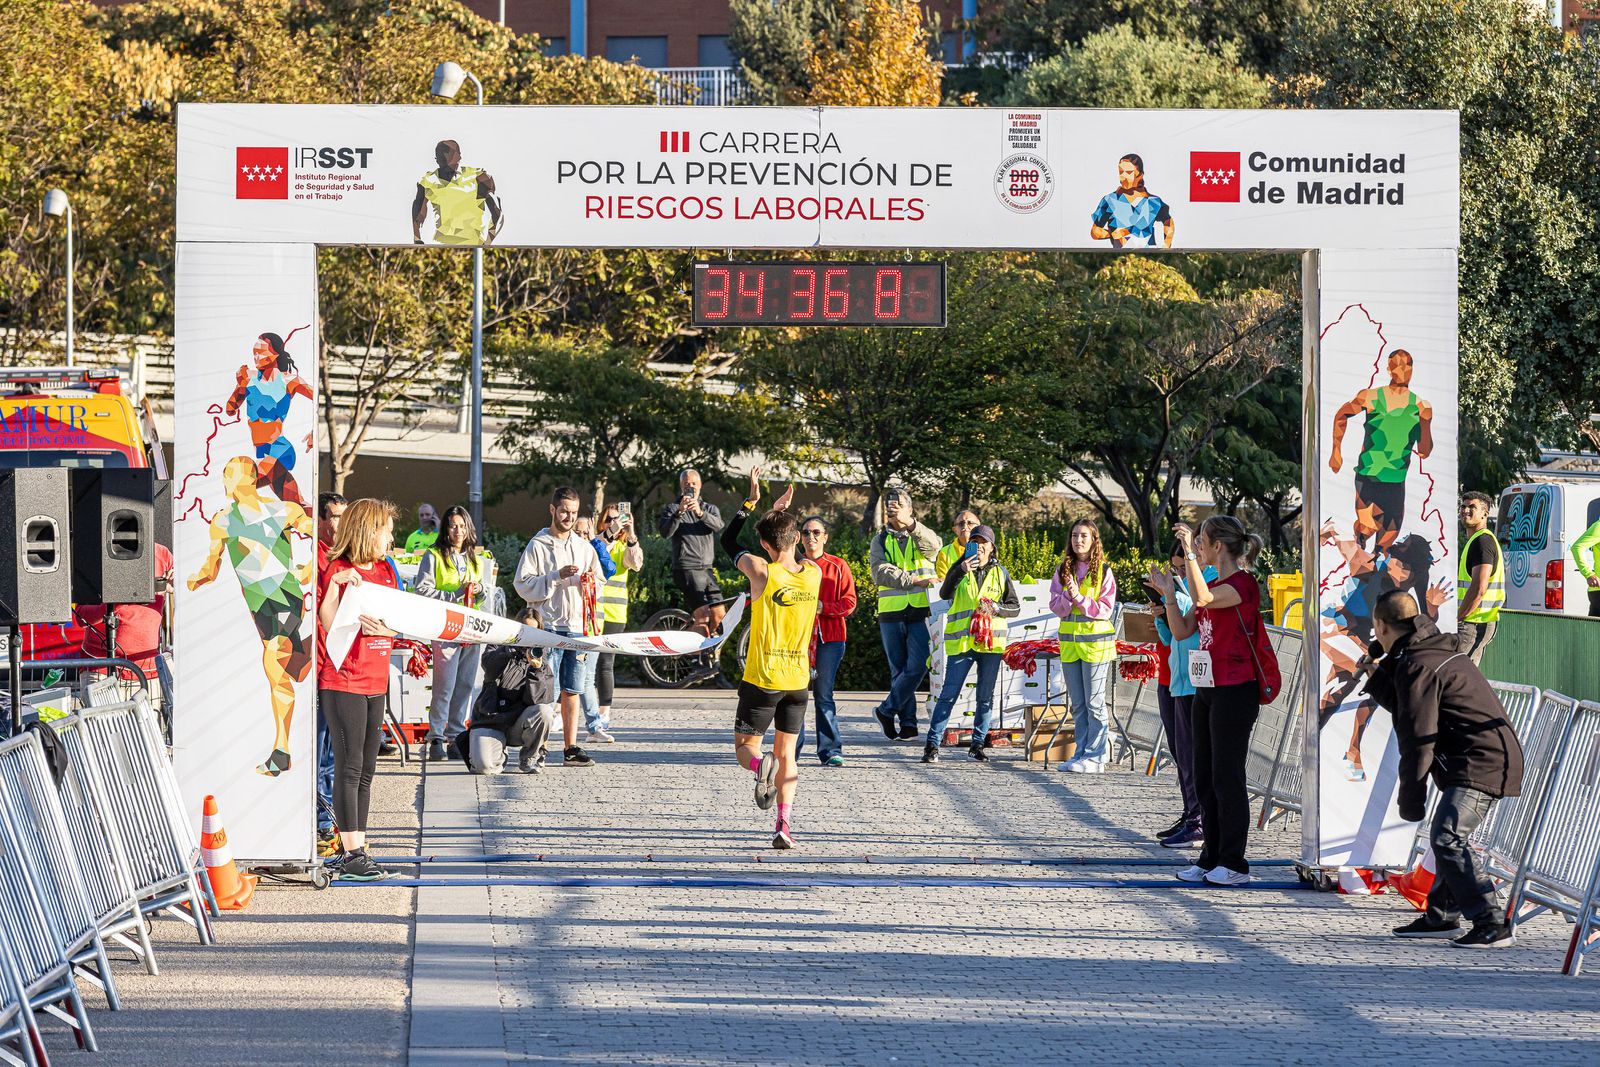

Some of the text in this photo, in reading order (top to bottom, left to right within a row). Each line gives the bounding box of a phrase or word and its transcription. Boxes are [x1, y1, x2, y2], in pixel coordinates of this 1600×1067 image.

[660, 131, 842, 153] III CARRERA
[295, 147, 373, 168] IRSST
[1003, 157, 1028, 169] REGIONAL
[1029, 157, 1047, 173] CONTRA
[1248, 151, 1405, 174] Comunidad
[328, 174, 361, 182] Regional
[558, 157, 952, 186] POR LA PREVENCIÓN DE
[1011, 170, 1039, 182] DRO
[306, 183, 345, 192] Seguridad
[315, 193, 343, 201] Trabajo
[1010, 184, 1037, 197] GAS
[1248, 181, 1404, 205] de Madrid
[585, 195, 925, 221] RIESGOS LABORALES
[704, 269, 764, 318] 34
[790, 269, 848, 318] 36
[466, 615, 493, 634] IRSST
[1192, 662, 1207, 675] 0897
